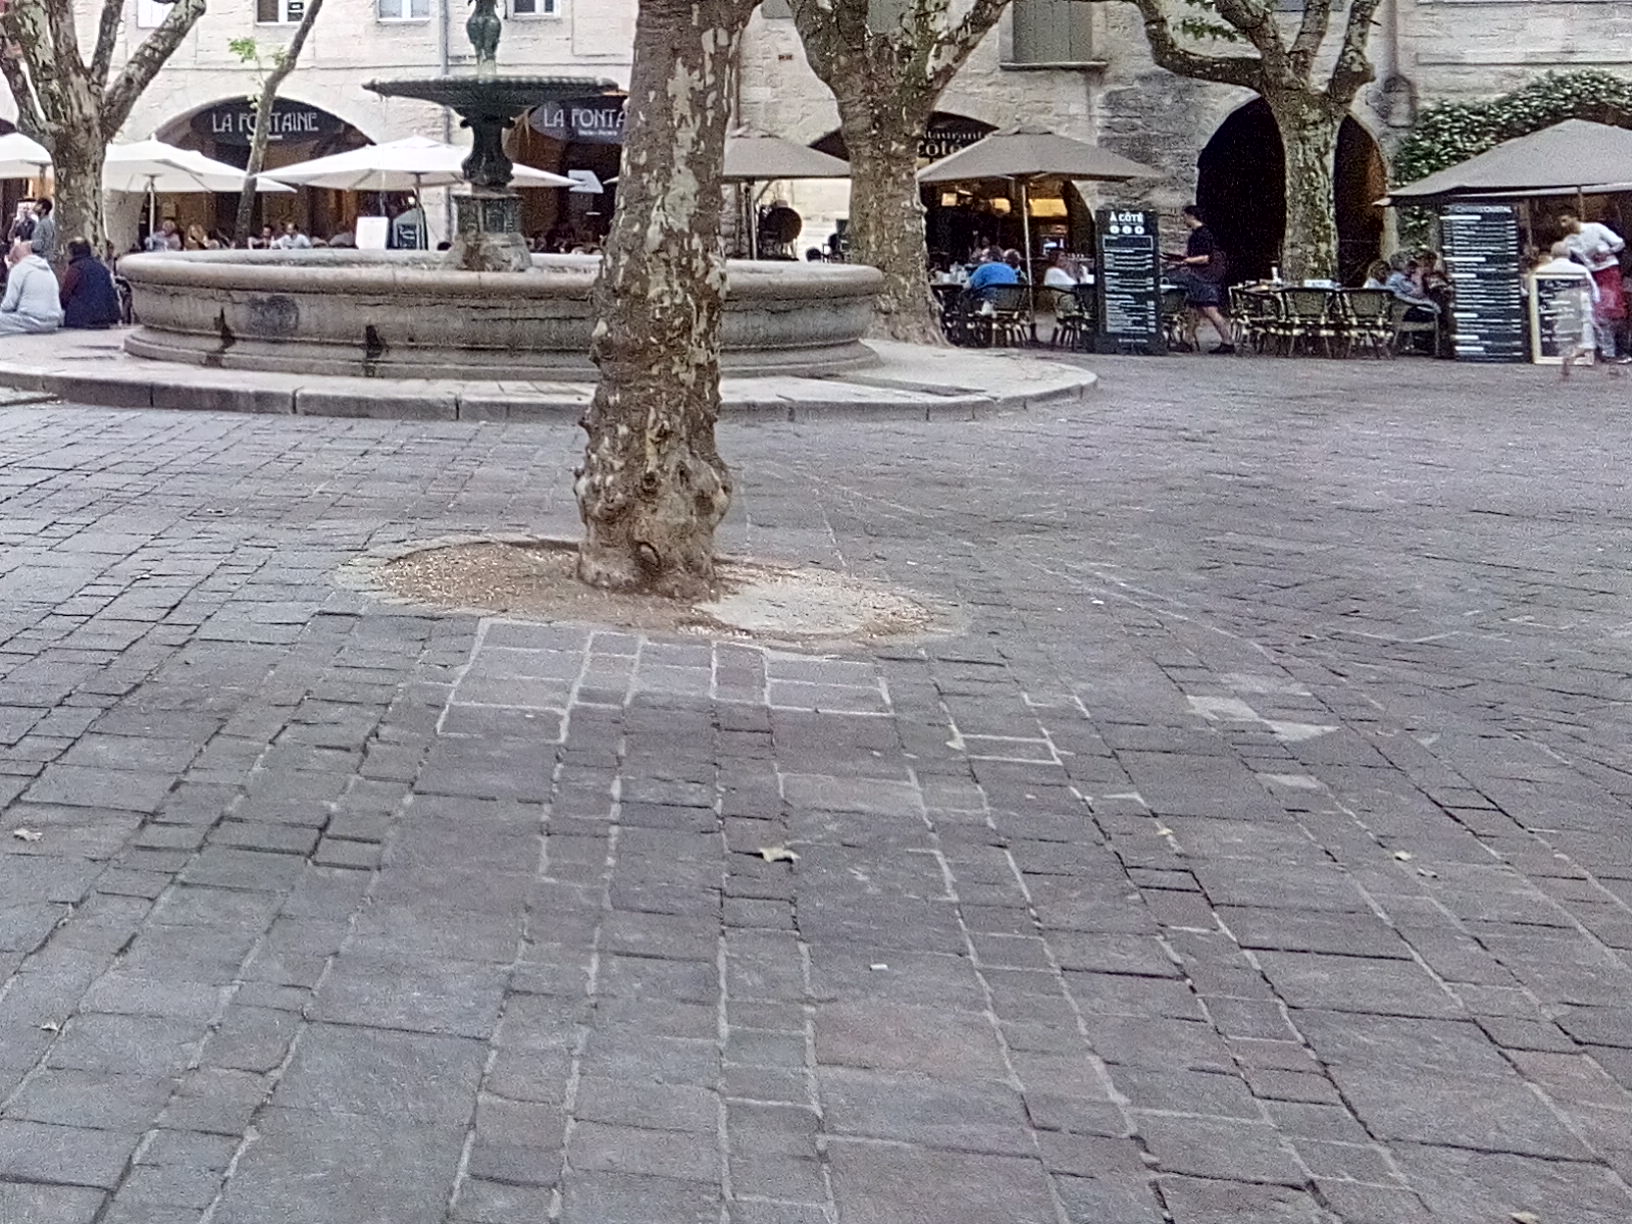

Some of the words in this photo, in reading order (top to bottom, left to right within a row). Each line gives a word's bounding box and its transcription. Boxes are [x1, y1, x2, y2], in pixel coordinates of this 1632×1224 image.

[212, 113, 233, 133] LA
[238, 112, 320, 133] FOTAINE
[543, 108, 565, 128] LA
